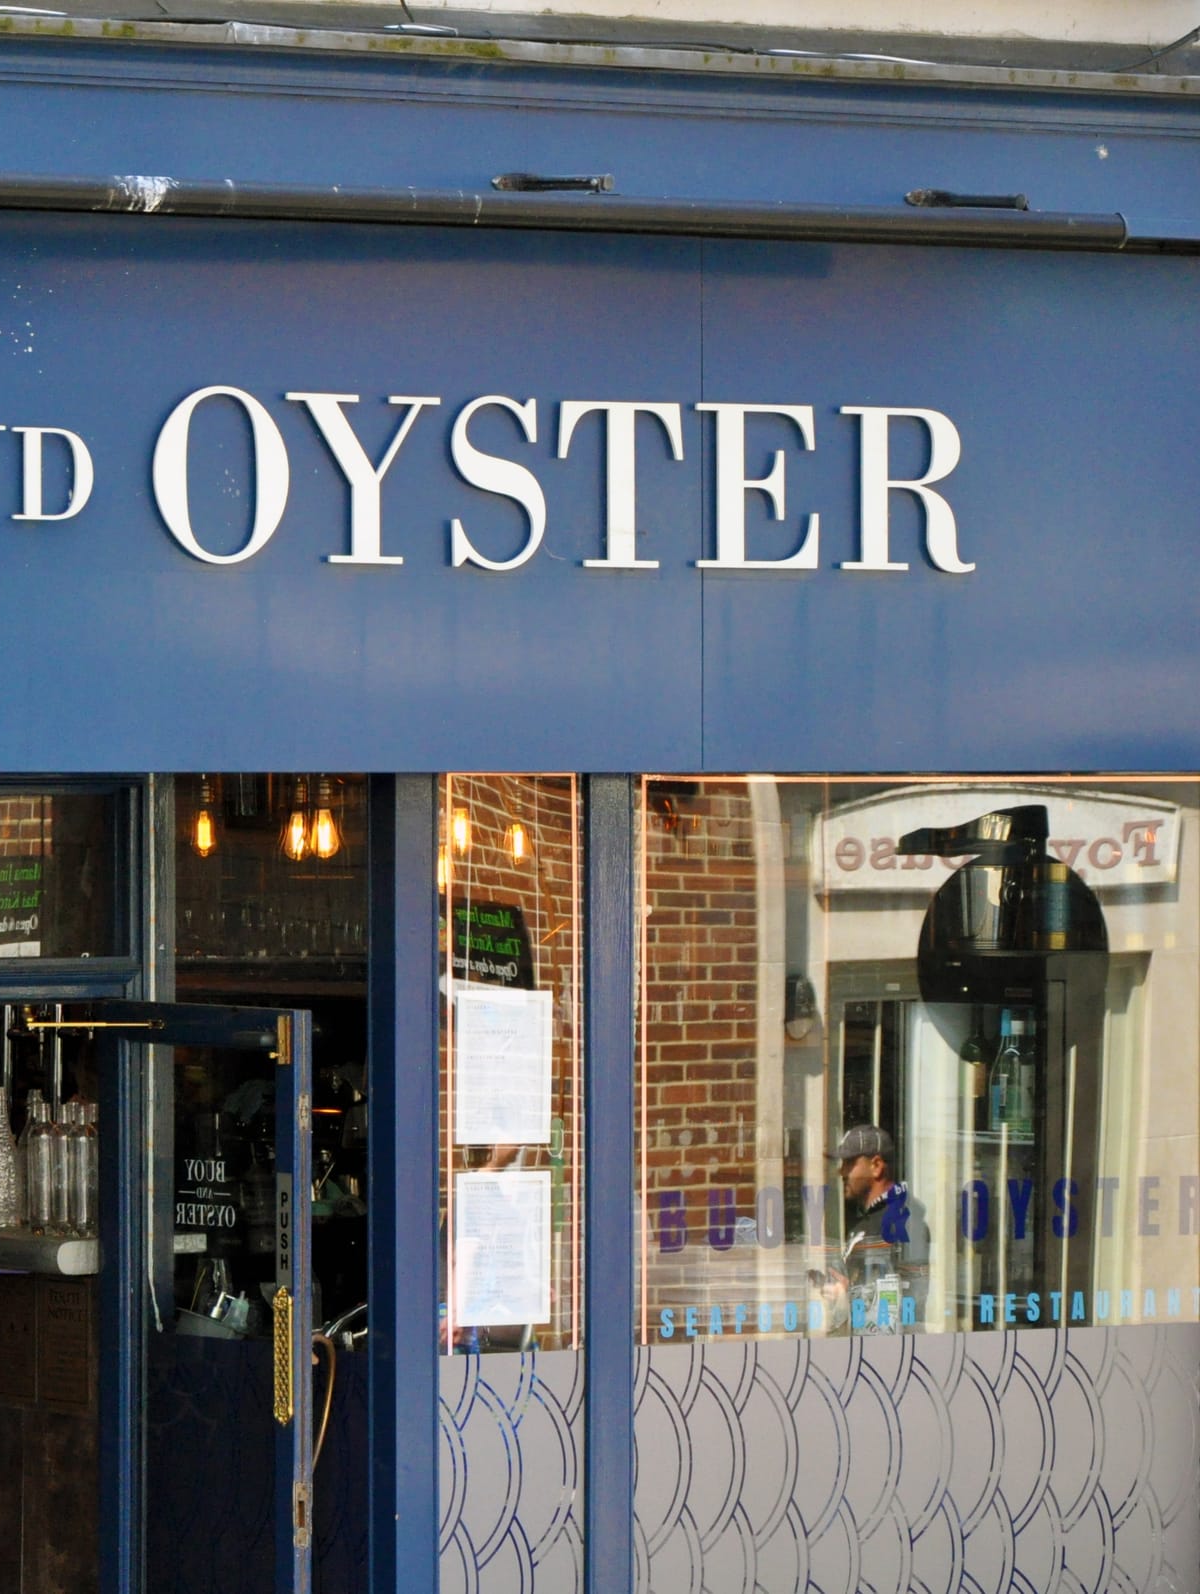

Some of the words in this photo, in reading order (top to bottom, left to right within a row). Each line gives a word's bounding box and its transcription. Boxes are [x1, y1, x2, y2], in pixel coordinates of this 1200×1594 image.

[152, 385, 976, 574] OYSTER
[280, 1191, 289, 1271] PUSH
[659, 1184, 829, 1254] BUOY
[962, 1174, 1200, 1242] OYSTER
[660, 1300, 825, 1338] SEAFOOD
[852, 1296, 917, 1329] BAR
